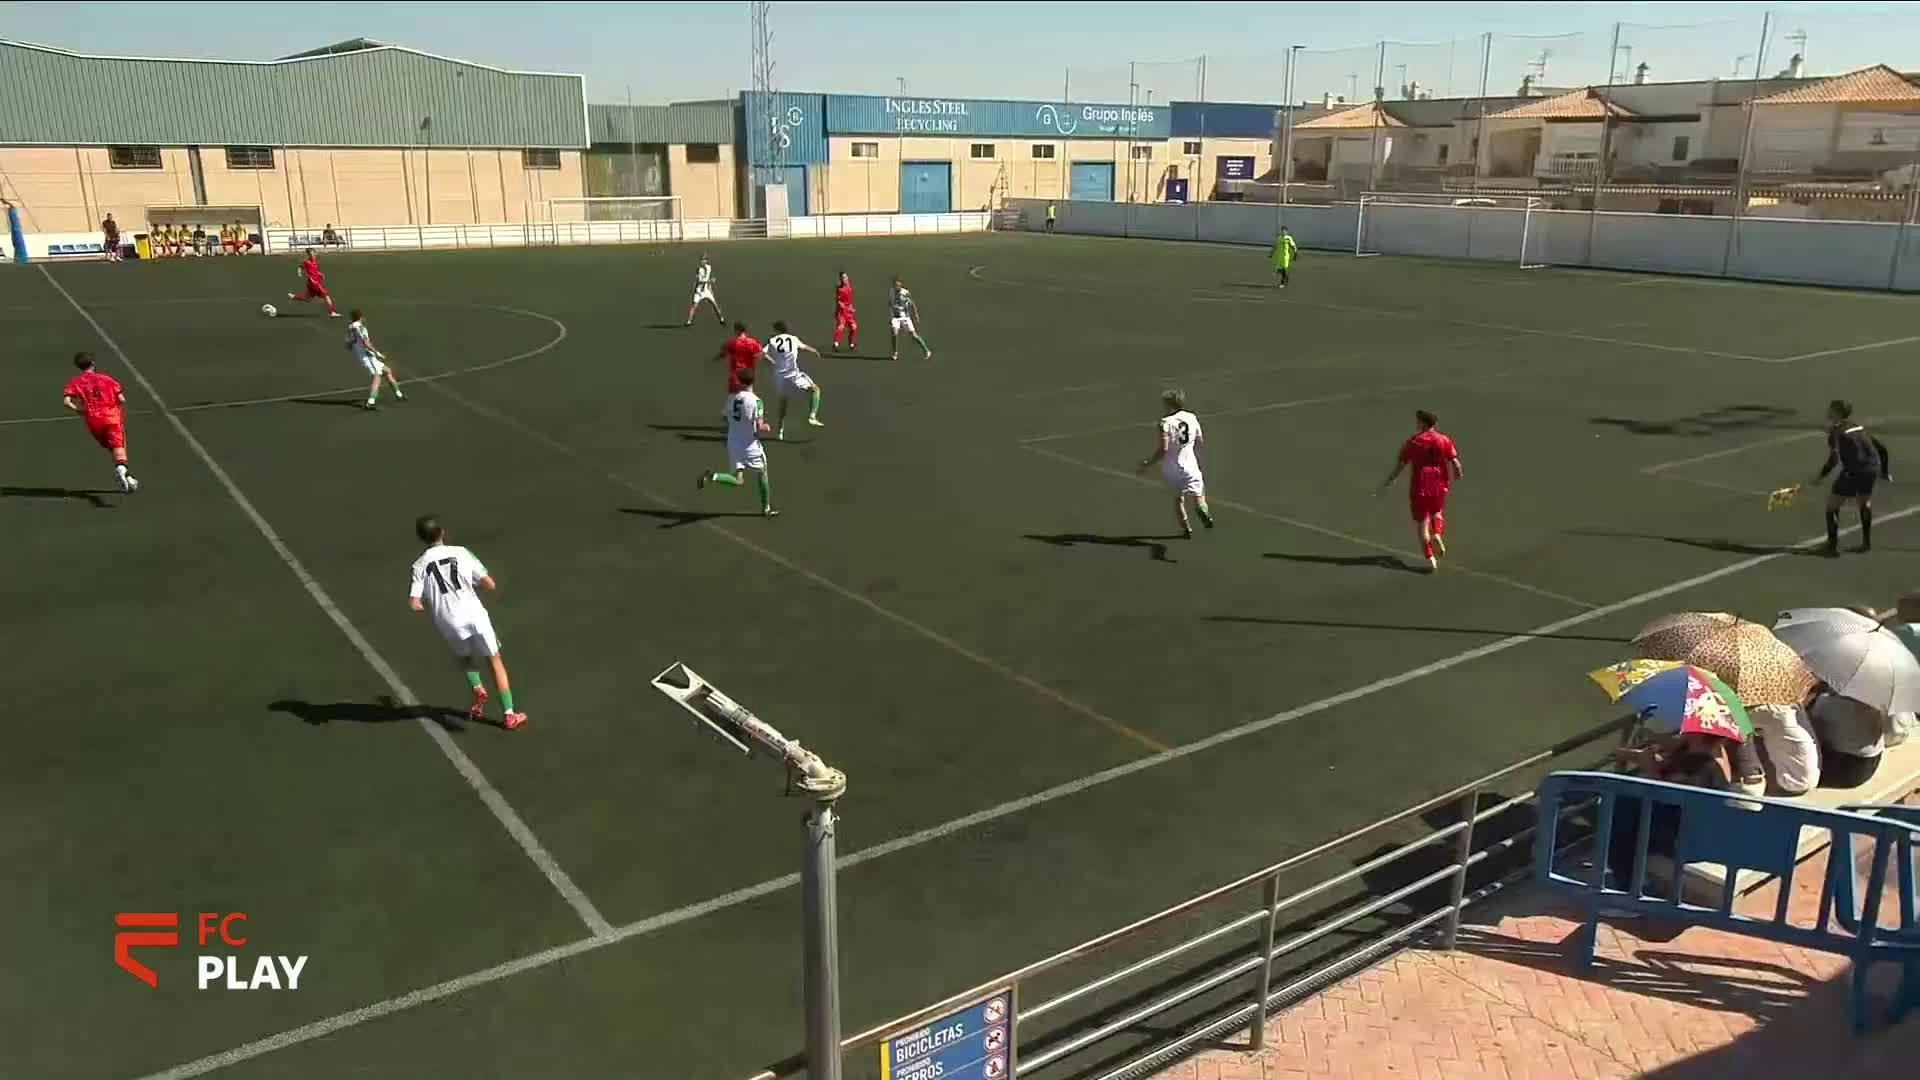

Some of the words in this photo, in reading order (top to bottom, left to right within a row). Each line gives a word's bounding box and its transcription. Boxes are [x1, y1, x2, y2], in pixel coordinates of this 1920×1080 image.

[1082, 106, 1118, 123] Grupo
[775, 337, 793, 353] 21
[733, 399, 743, 422] 5
[425, 556, 462, 595] 17
[896, 1023, 963, 1063] BICICLETAS
[897, 1061, 944, 1080] RROS
